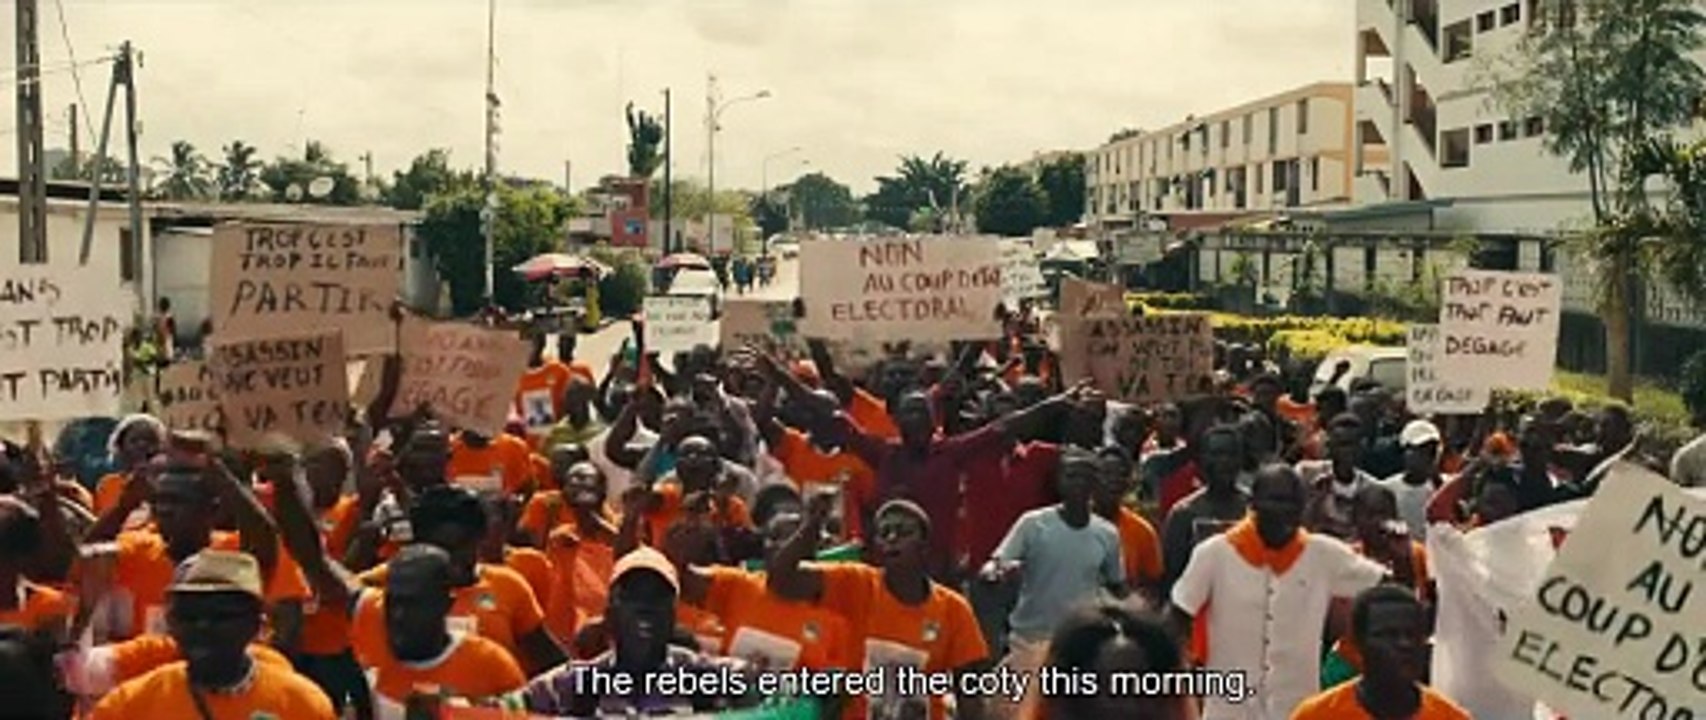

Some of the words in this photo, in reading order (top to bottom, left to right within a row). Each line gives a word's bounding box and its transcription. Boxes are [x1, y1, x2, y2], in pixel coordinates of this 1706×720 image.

[858, 240, 923, 267] NON
[862, 272, 893, 295] AU
[900, 268, 954, 292] COUP
[1625, 561, 1694, 614] AU
[1536, 576, 1653, 647] COUP
